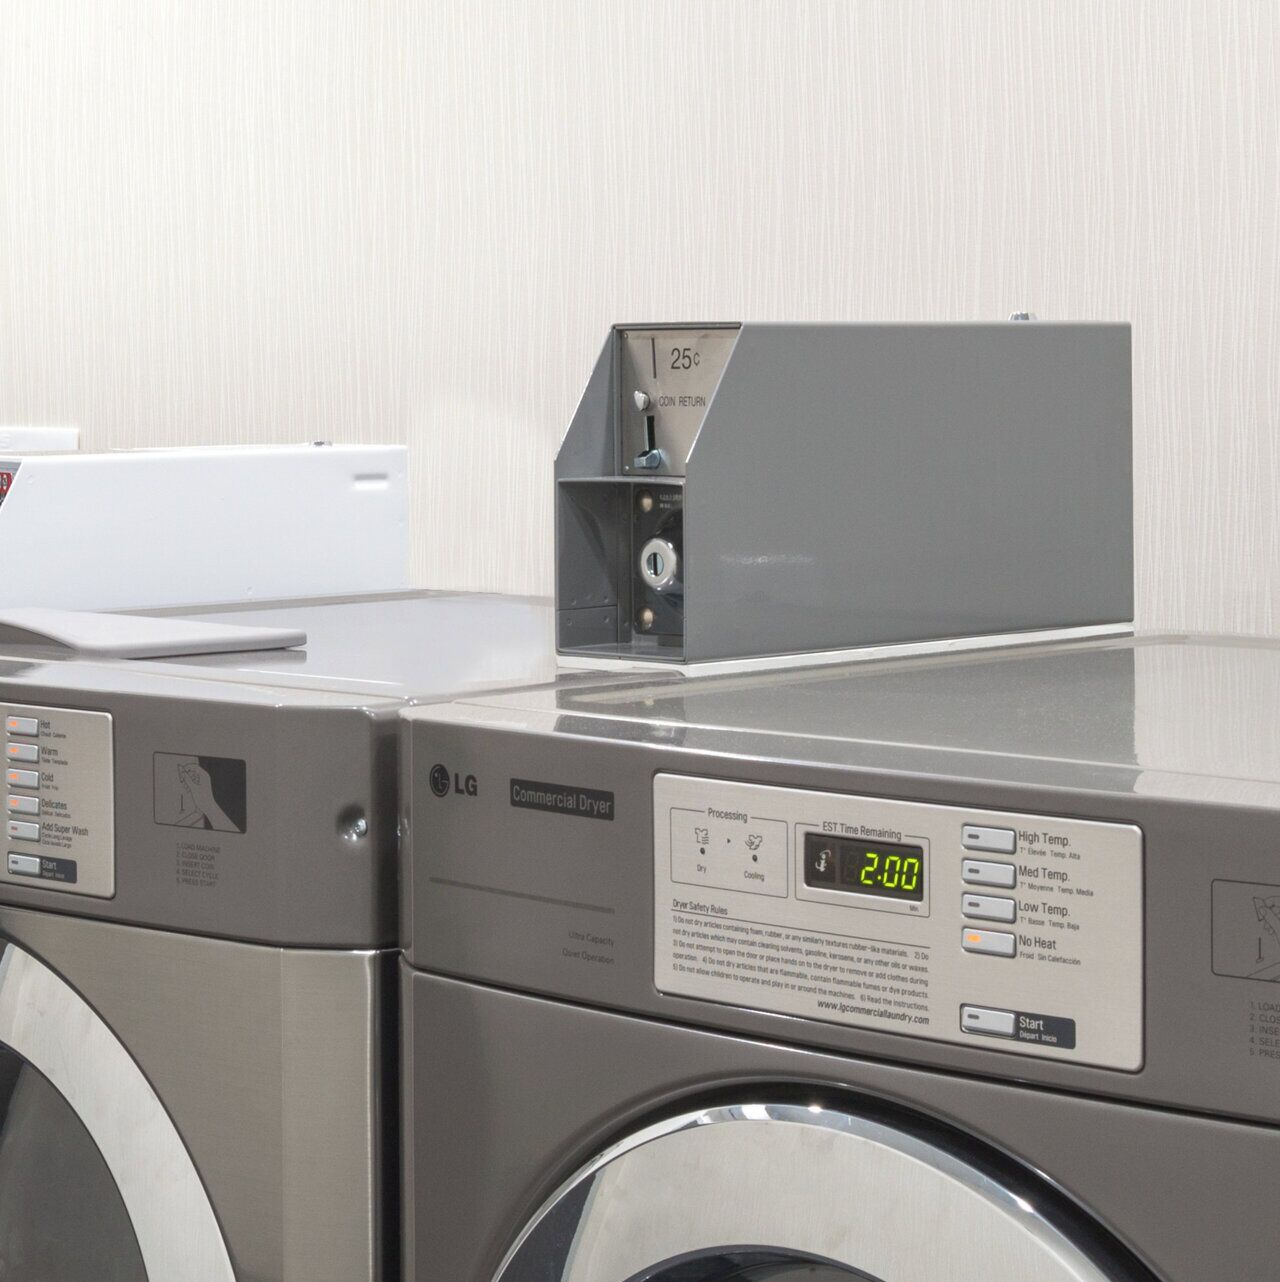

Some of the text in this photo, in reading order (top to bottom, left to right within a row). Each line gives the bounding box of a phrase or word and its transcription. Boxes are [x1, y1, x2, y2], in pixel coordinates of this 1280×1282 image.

[671, 348, 700, 369] 25¢
[659, 396, 706, 407] COIN RETURN
[40, 720, 50, 729] Hot
[41, 746, 58, 756] Warm
[41, 773, 54, 782] Cold
[455, 773, 477, 796] LG
[41, 799, 67, 811] Delicates
[512, 785, 611, 814] Commercial Dryer
[707, 807, 748, 824] Processing
[42, 822, 88, 836] Add Super Wash
[860, 825, 902, 841] Remaining
[1018, 830, 1071, 847] High Temp.
[42, 860, 57, 870] Start
[696, 864, 707, 874] Dry
[744, 870, 765, 882] Cooling
[1018, 865, 1070, 882] Med Temp.
[672, 898, 727, 914] Dryer Safety Rules
[1018, 900, 1070, 917] Low Temp.
[685, 917, 693, 925] not
[694, 918, 702, 928] dry
[703, 919, 721, 929] articles
[722, 922, 748, 934] containing
[749, 926, 763, 937] foam,
[791, 934, 801, 942] any
[802, 934, 823, 946] similarly
[825, 937, 847, 948] textures
[849, 941, 879, 953] rubber-like
[881, 946, 907, 957] materials.
[1019, 935, 1057, 950] No Heat
[681, 929, 689, 938] dry
[691, 930, 709, 939] articles
[710, 933, 725, 942] which
[737, 937, 756, 947] contain
[757, 940, 779, 952] cleaning
[780, 944, 804, 955] solvents,
[804, 947, 828, 959] gasoline,
[828, 951, 855, 963] kerosene,
[863, 958, 873, 966] any
[874, 958, 889, 967] other
[890, 960, 900, 969] oils
[908, 965, 928, 973] waxes.
[1019, 951, 1035, 960] Froid
[686, 941, 694, 949] not
[695, 943, 715, 953] attempt
[722, 949, 735, 957] open
[736, 949, 744, 957] the
[746, 951, 757, 959] door
[765, 954, 779, 963] place
[780, 956, 796, 965] hands
[813, 961, 822, 969] the
[823, 963, 838, 973] dryer
[846, 968, 866, 976] remove
[875, 971, 886, 979] add
[887, 973, 908, 982] clothes
[909, 976, 928, 987] during
[672, 951, 697, 962] operation.
[716, 958, 724, 966] not
[725, 959, 734, 968] dry
[736, 961, 755, 970] articles
[757, 964, 768, 972] that
[779, 968, 809, 980] flammable,
[810, 973, 831, 983] contain
[832, 976, 861, 987] flammable
[862, 981, 880, 990] fumes
[889, 985, 899, 995] dye
[901, 987, 928, 999] products.
[817, 1000, 930, 1025] www.lgcommerciallaundry.com
[1019, 1017, 1044, 1030] Start
